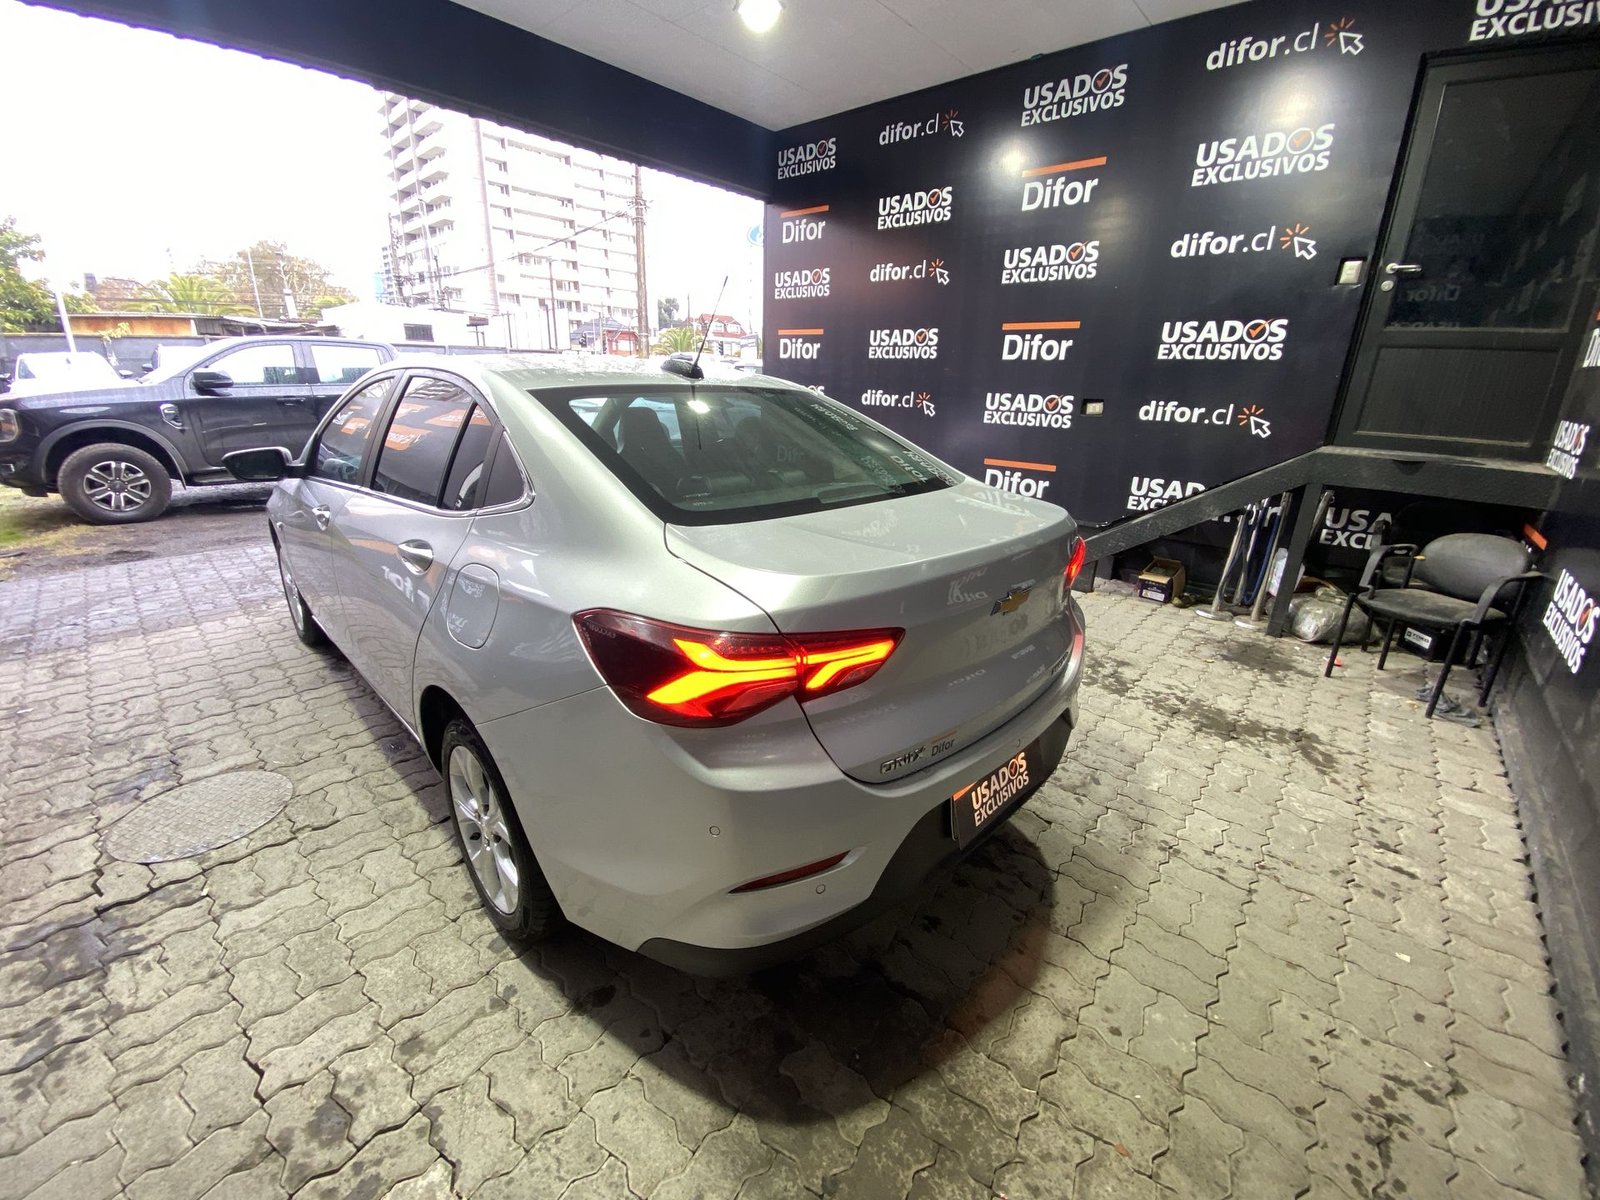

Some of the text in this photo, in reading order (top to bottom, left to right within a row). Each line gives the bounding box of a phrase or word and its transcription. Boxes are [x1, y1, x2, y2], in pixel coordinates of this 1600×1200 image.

[1206, 22, 1320, 71] difor.cl
[1023, 64, 1129, 109] USADOS
[1021, 89, 1126, 127] EXCLUSIVOS
[879, 113, 939, 146] difor.cl
[778, 137, 837, 167] USADOS
[1195, 123, 1336, 167] USADOS
[777, 155, 836, 180] EXCLUSIVOS
[1191, 151, 1331, 187] EXCLUSIVOS
[878, 186, 953, 215] USADOS
[1021, 176, 1099, 211] Difor
[782, 218, 826, 244] Difor
[877, 207, 951, 230] EXCLUSIVOS
[1003, 240, 1100, 268] USADOS
[1170, 225, 1276, 259] difor.cl
[775, 267, 830, 288] USADOS
[869, 259, 926, 282] difor.cl
[1001, 263, 1098, 284] EXCLUSIVOS
[774, 284, 830, 300] EXCLUSIVOS
[869, 327, 938, 347] USADOS
[1161, 318, 1289, 343] USADOS
[779, 338, 821, 360] Difor
[868, 345, 937, 360] EXCLUSIVOS
[1002, 334, 1073, 361] Difor
[1157, 343, 1283, 361] EXCLUSIVOS
[861, 389, 914, 408] difor.cl
[985, 392, 1075, 415] USADOS
[983, 411, 1072, 429] EXCLUSIVOS
[1138, 400, 1234, 426] difor.cl
[1554, 420, 1590, 456] USADOS
[1546, 448, 1580, 480] EXCLUSIVOS
[984, 469, 1050, 499] Difor
[1554, 568, 1600, 645] USADOS
[1543, 600, 1585, 675] EXCLUSIVOS
[931, 739, 956, 757] Difor
[971, 752, 1028, 810] USADOS
[973, 771, 1030, 827] EXCLUSIVOS
